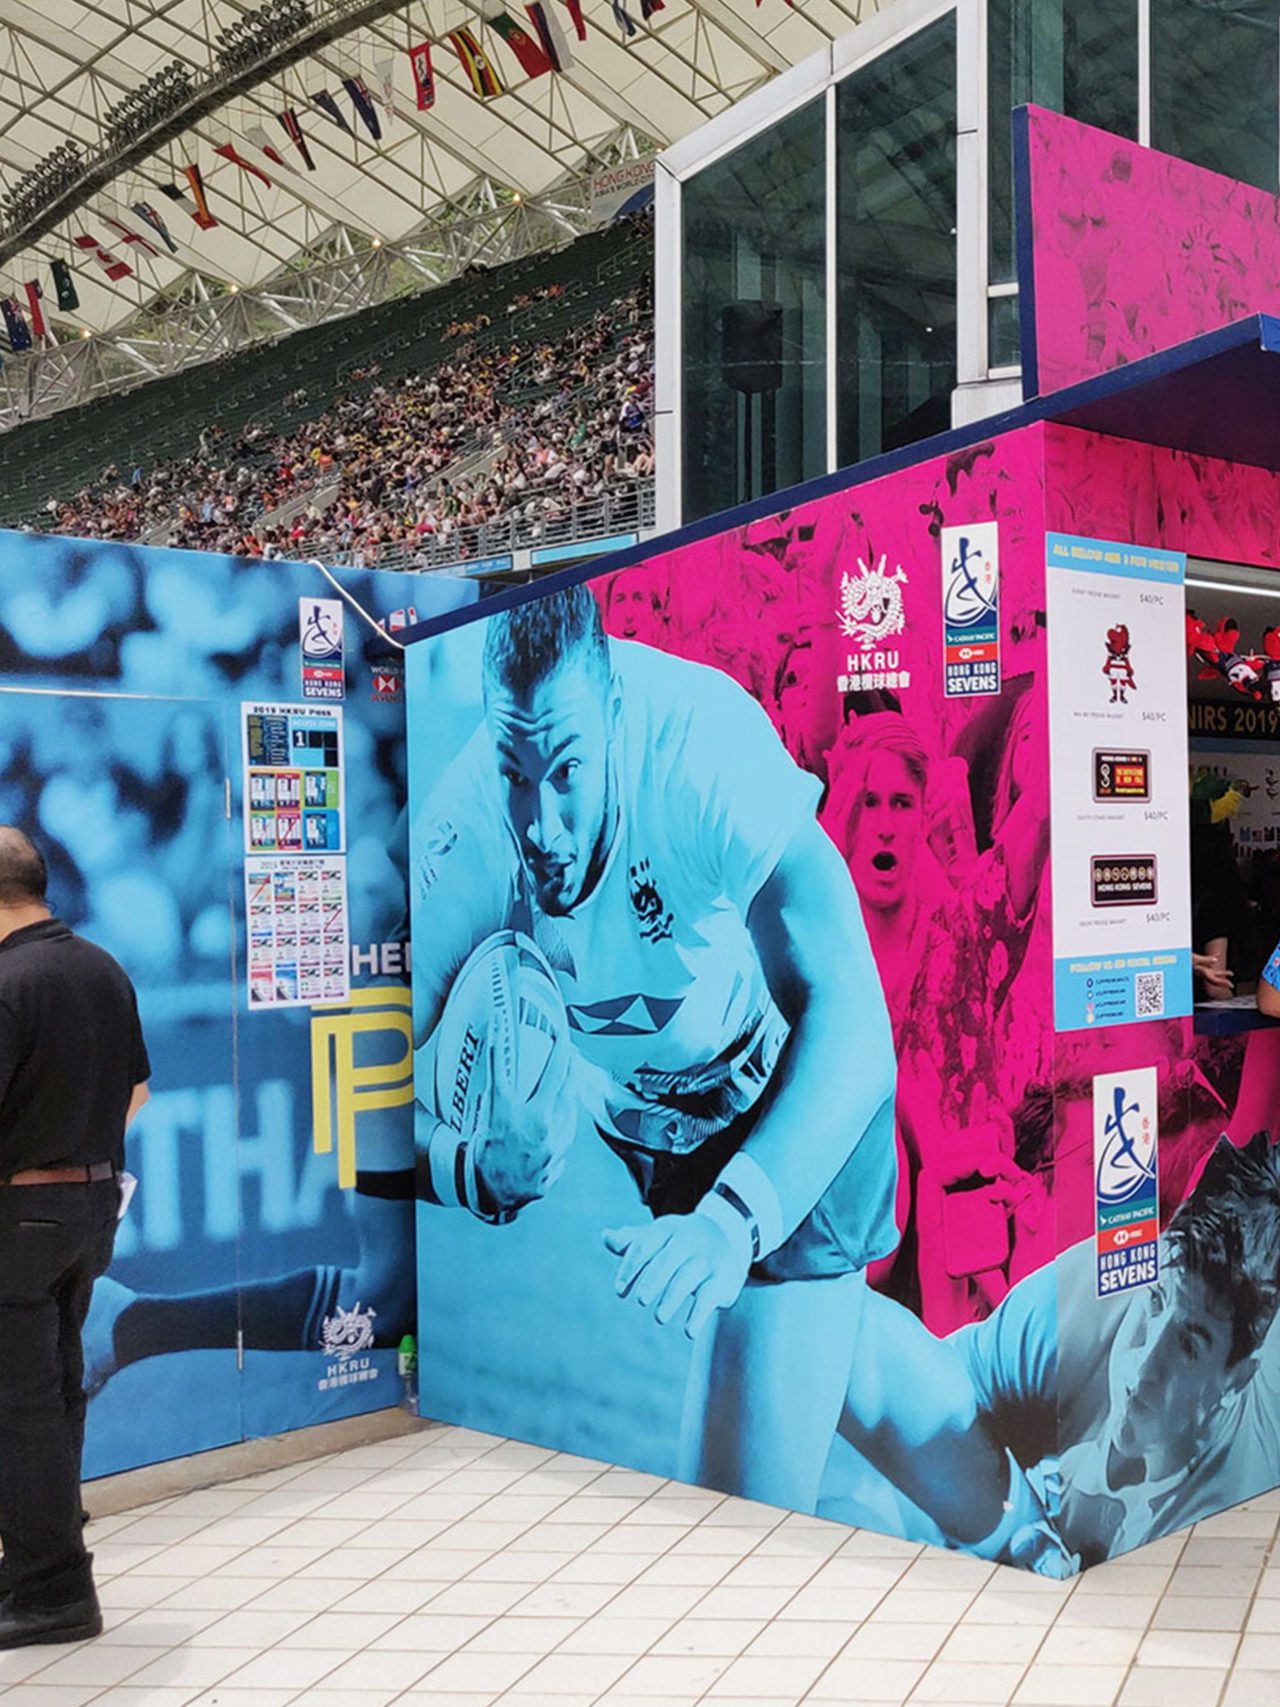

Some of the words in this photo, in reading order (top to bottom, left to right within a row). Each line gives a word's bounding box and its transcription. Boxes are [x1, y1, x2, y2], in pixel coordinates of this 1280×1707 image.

[847, 651, 899, 671] HKRU
[948, 665, 970, 676] HONG
[974, 662, 997, 674] KONG
[305, 687, 341, 697] SEVENS
[948, 676, 997, 693] SEVENS
[1234, 706, 1280, 733] 2019
[1100, 1251, 1126, 1271] HONG
[1130, 1243, 1156, 1263] KONG
[1100, 1260, 1156, 1292] SEVENS
[327, 1357, 370, 1378] HKRU
